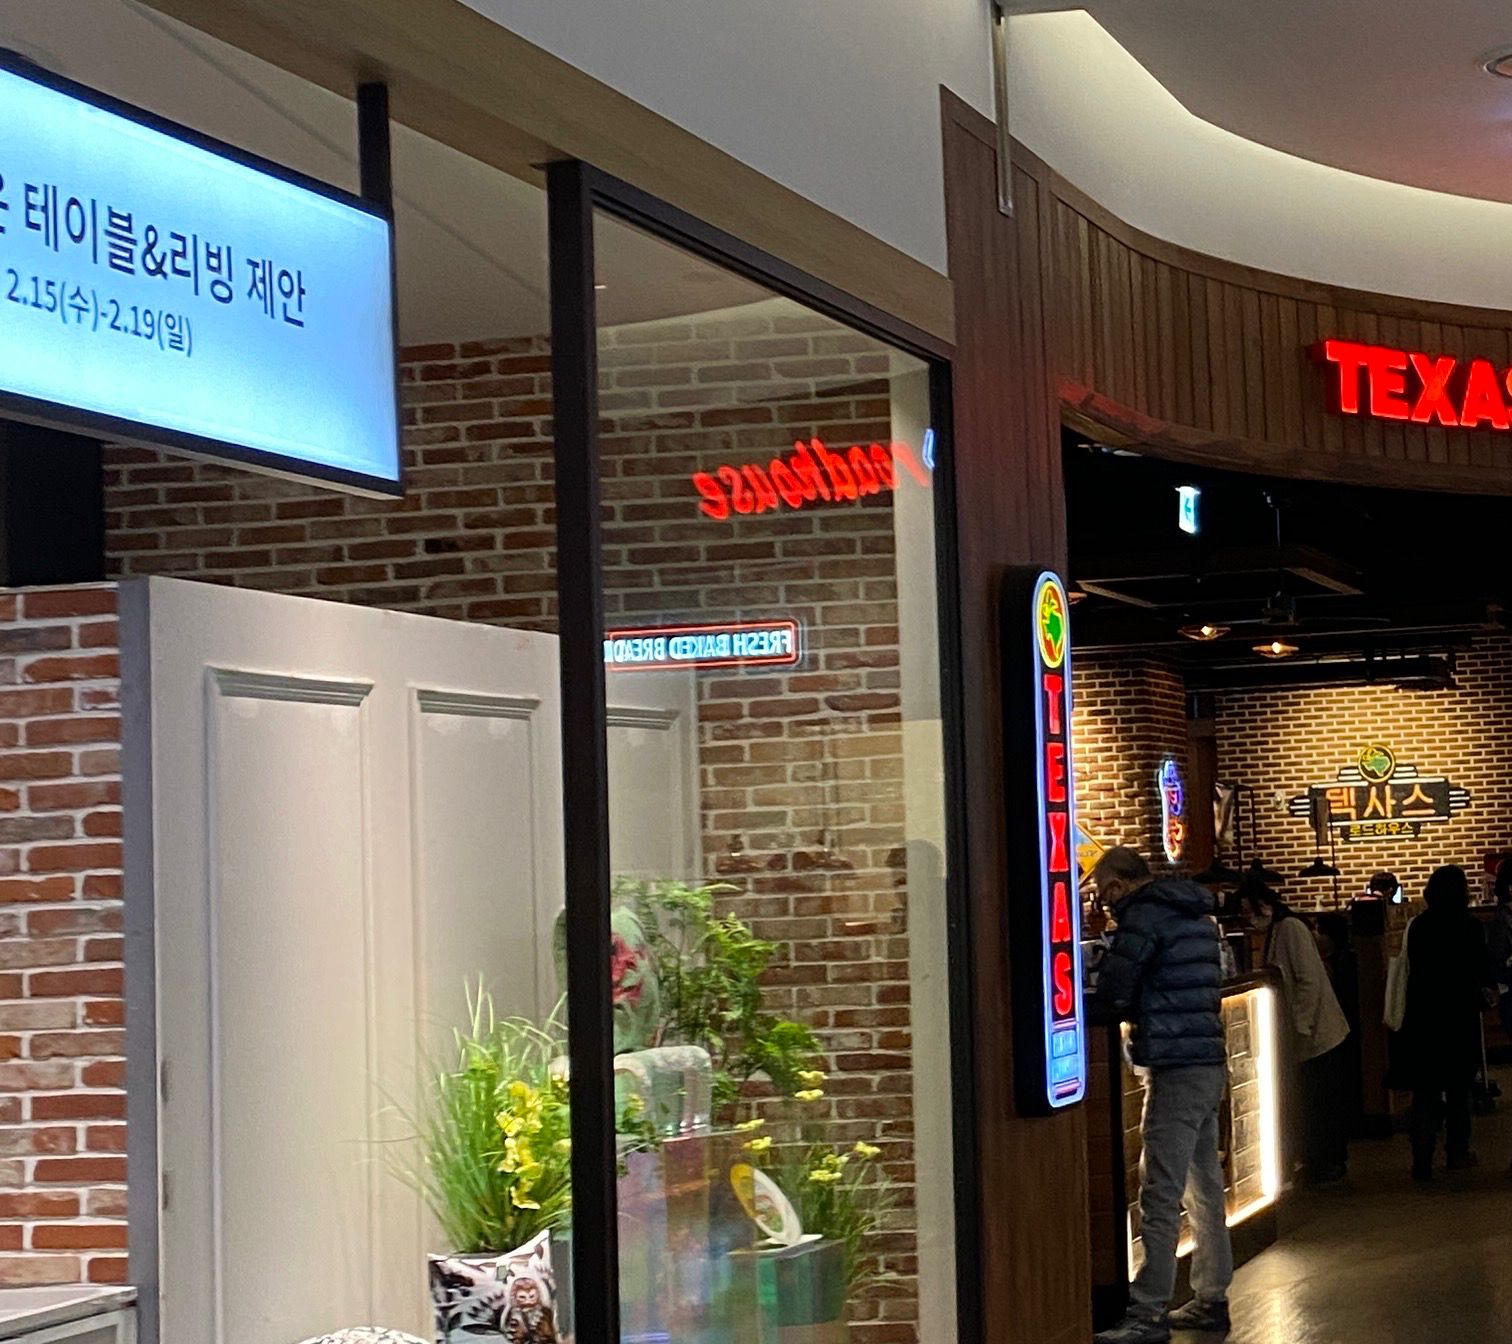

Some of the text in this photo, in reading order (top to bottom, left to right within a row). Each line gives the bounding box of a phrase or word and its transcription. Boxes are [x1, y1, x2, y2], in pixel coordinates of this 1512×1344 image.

[25, 182, 234, 304] 테이블&리빙
[246, 257, 306, 327] 제안
[6, 268, 192, 357] 2.15(수)-2.19(일)
[1044, 674, 1073, 1015] TEXAS
[1325, 784, 1436, 820] 텍사스
[1349, 821, 1414, 836] 로드하우스
